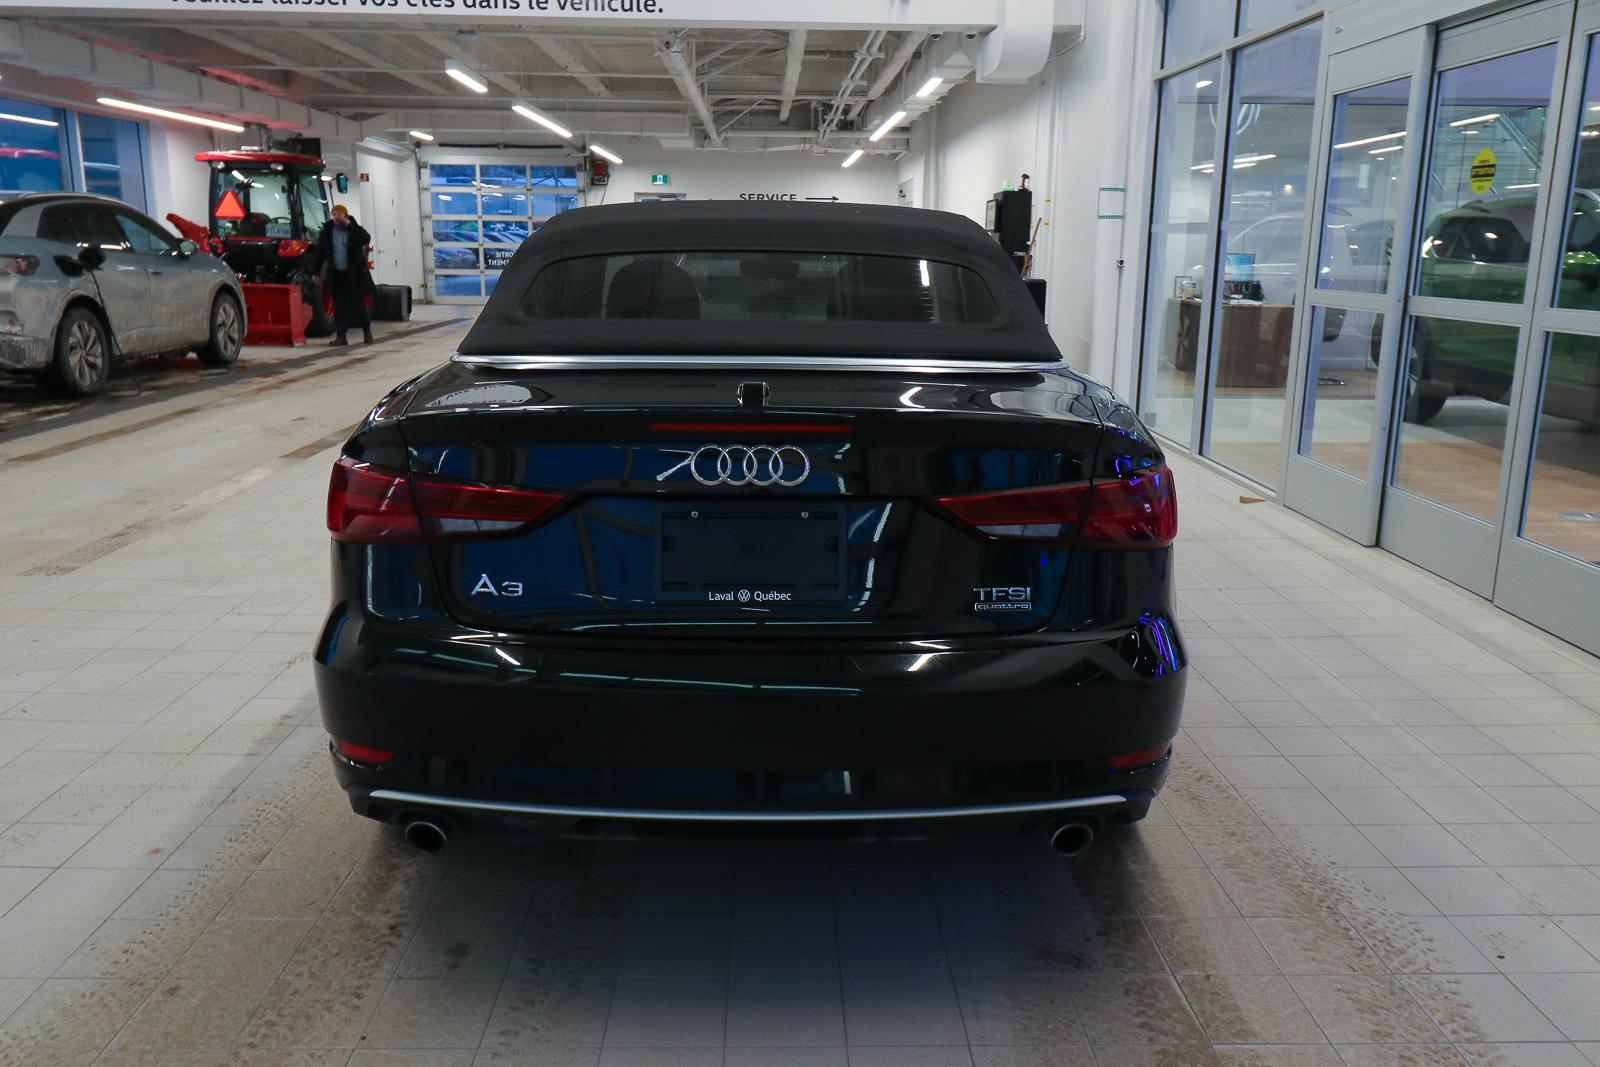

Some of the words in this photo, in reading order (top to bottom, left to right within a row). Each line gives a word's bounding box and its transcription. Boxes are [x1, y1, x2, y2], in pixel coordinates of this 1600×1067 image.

[739, 193, 797, 201] SERVICE
[471, 573, 523, 597] A3
[708, 591, 734, 601] Laval
[754, 590, 792, 602] Québec
[973, 587, 1031, 601] TFSI
[976, 602, 1030, 611] quattro
